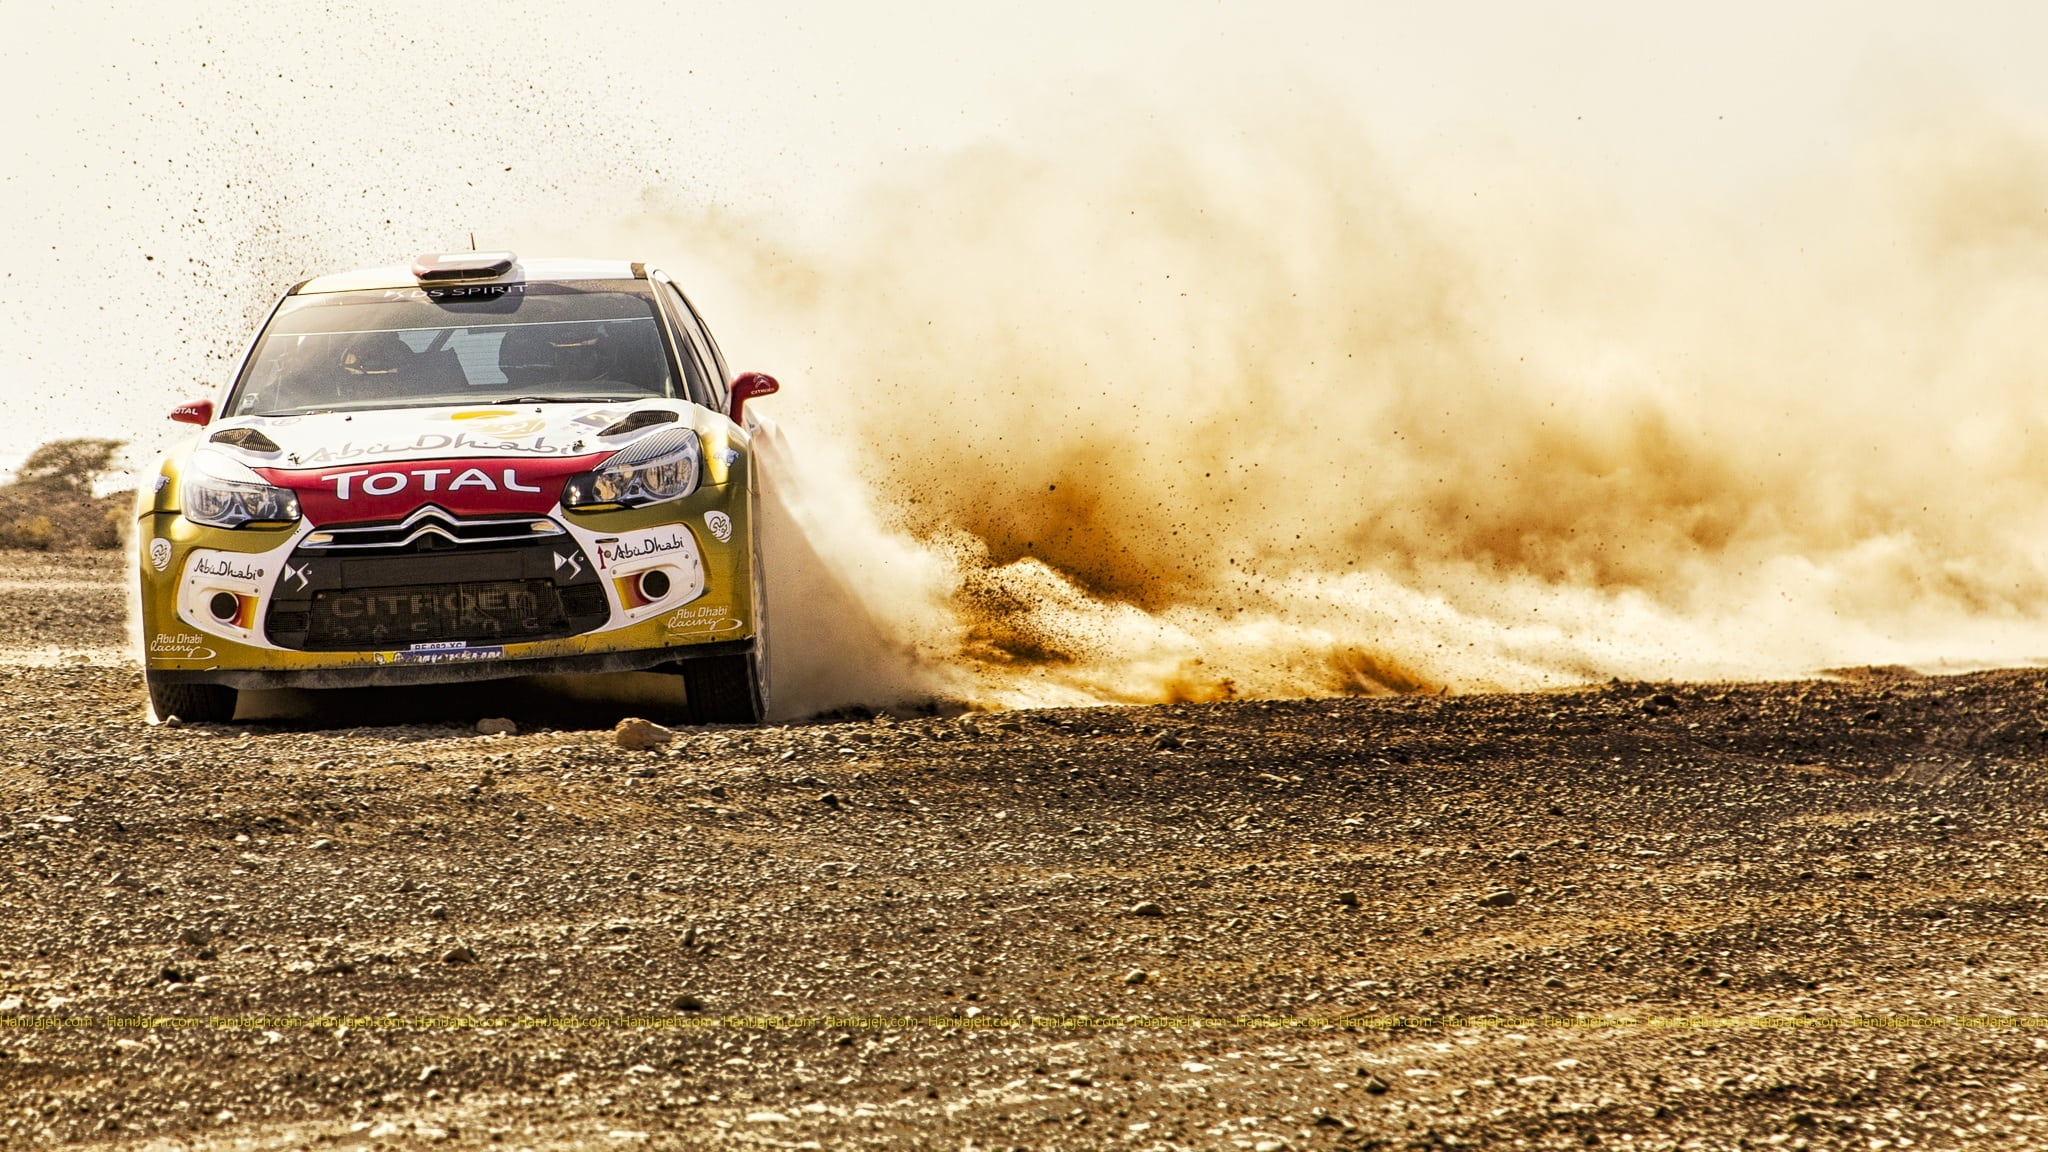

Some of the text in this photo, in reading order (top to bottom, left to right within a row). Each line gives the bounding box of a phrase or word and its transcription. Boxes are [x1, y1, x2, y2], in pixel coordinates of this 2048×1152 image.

[451, 284, 529, 296] SPIRIT
[321, 468, 541, 500] TOTAL
[676, 605, 728, 619] Abu Dhabi
[667, 617, 726, 631] Racing
[156, 633, 203, 645] Abu Dhabi
[150, 640, 197, 658] Racing
